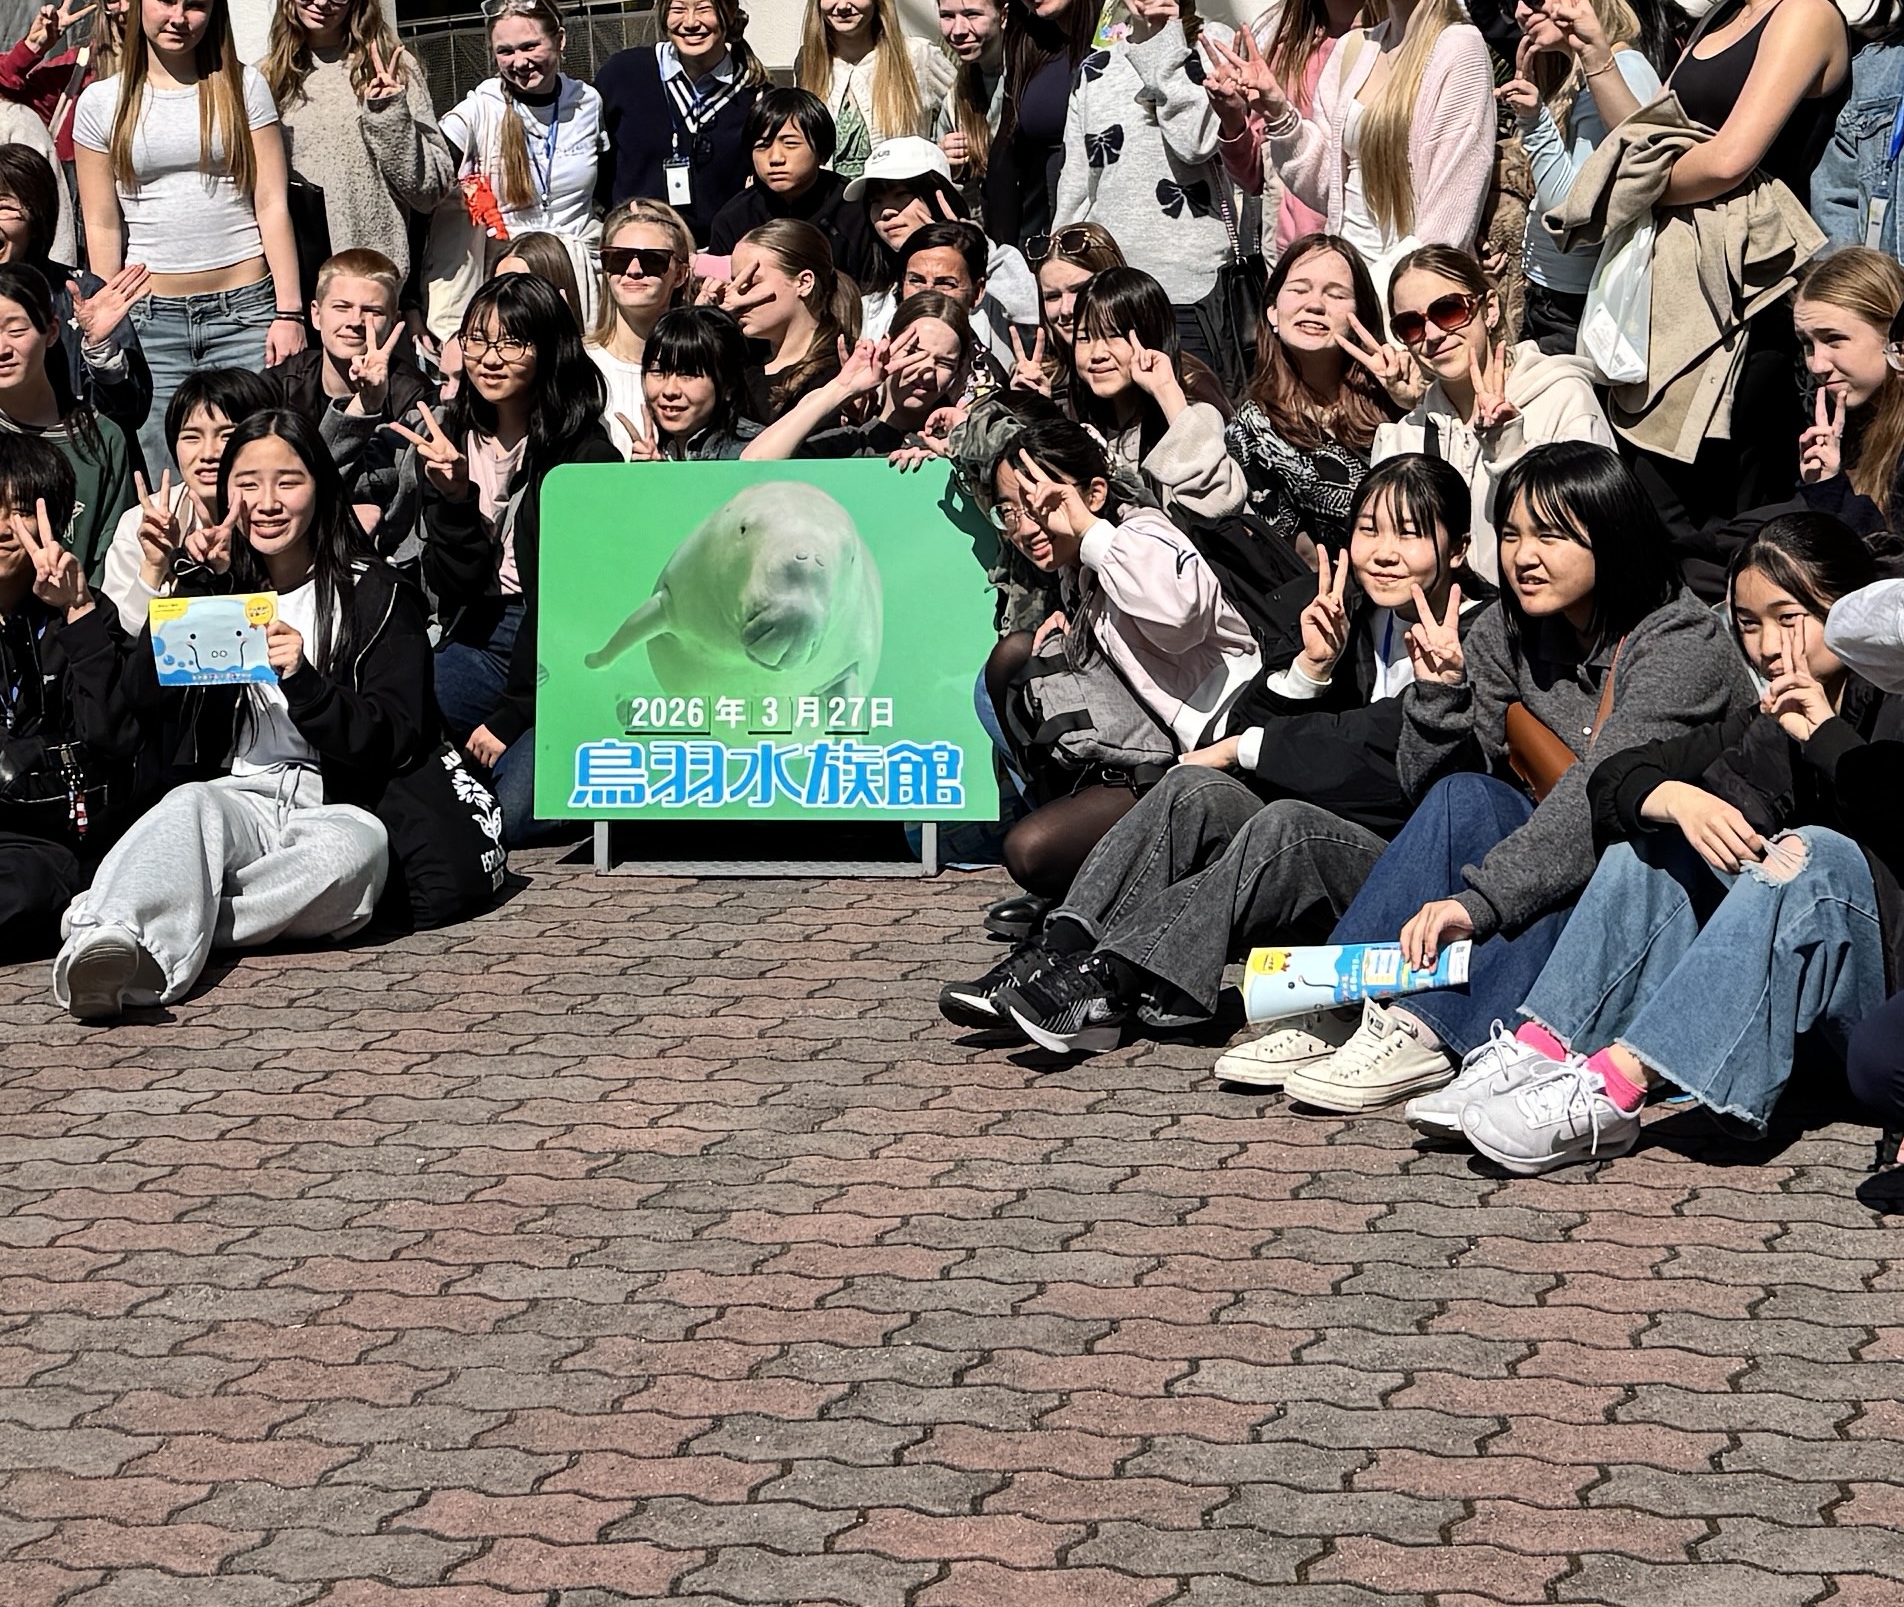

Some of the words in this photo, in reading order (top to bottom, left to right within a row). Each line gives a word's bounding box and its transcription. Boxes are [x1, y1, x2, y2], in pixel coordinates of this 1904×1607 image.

[568, 739, 966, 810] 鳥羽水族館
